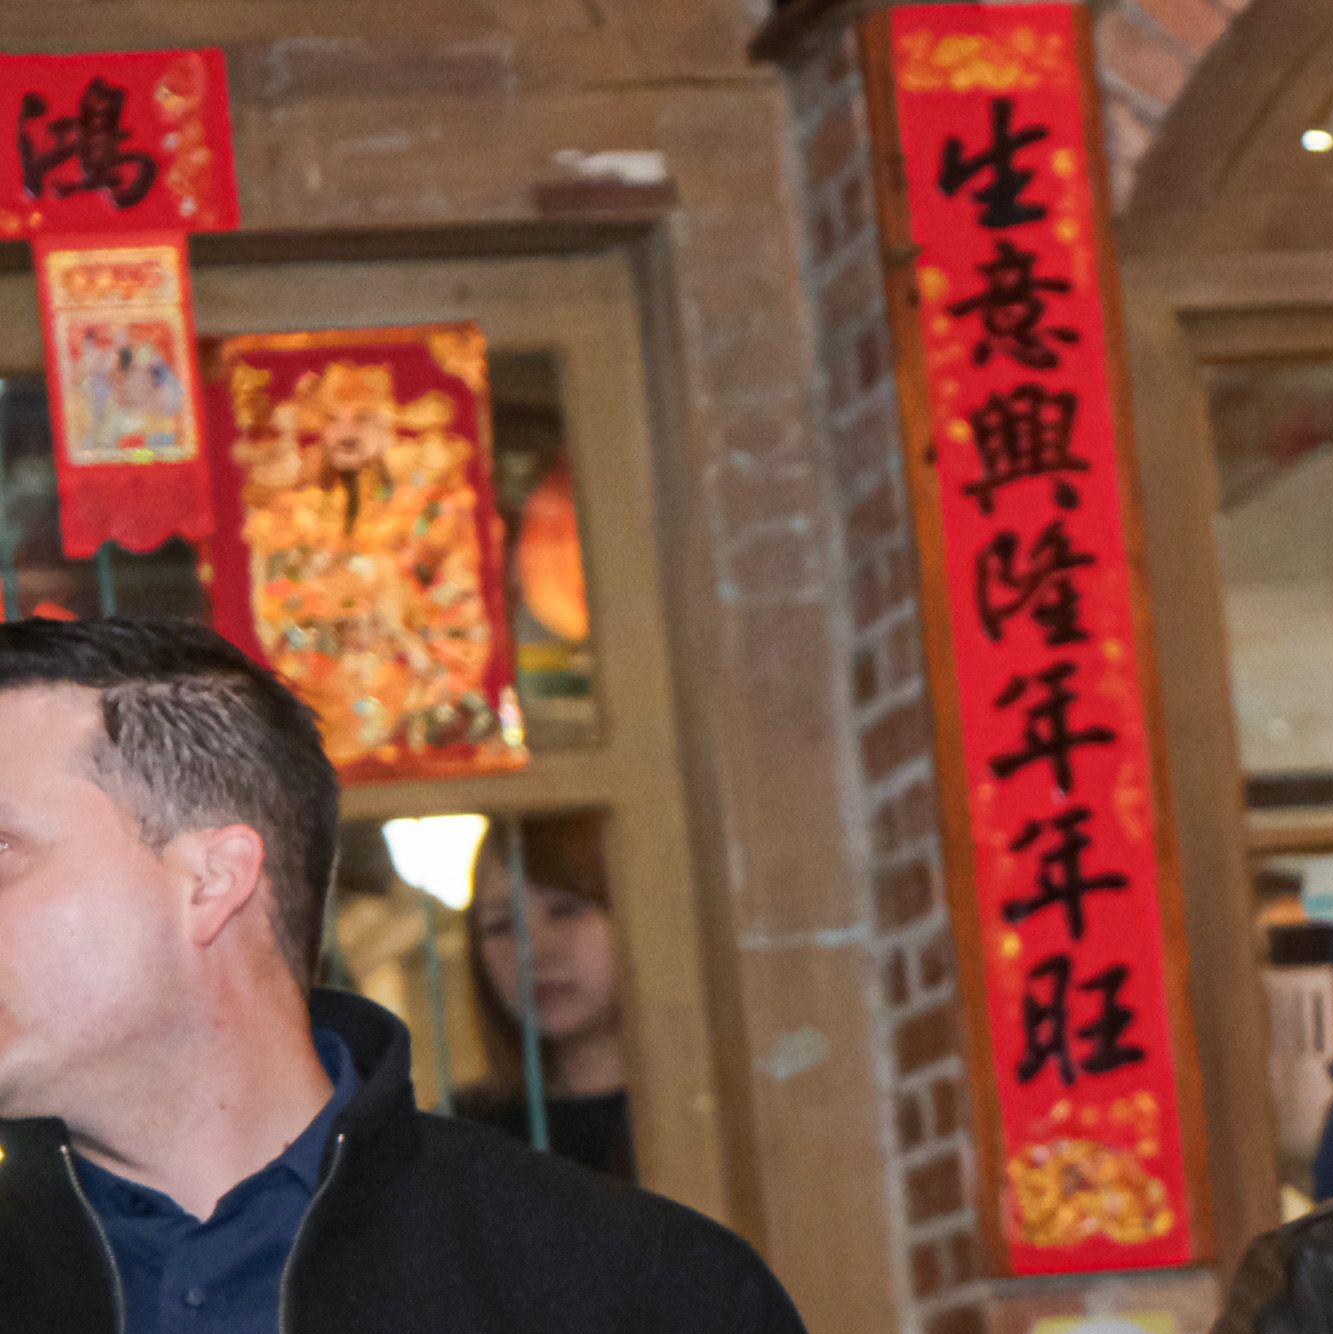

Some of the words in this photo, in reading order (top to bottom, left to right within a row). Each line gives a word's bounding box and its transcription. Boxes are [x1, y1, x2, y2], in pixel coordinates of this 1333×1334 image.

[938, 97, 1147, 1086] 生意興隆年年旺
